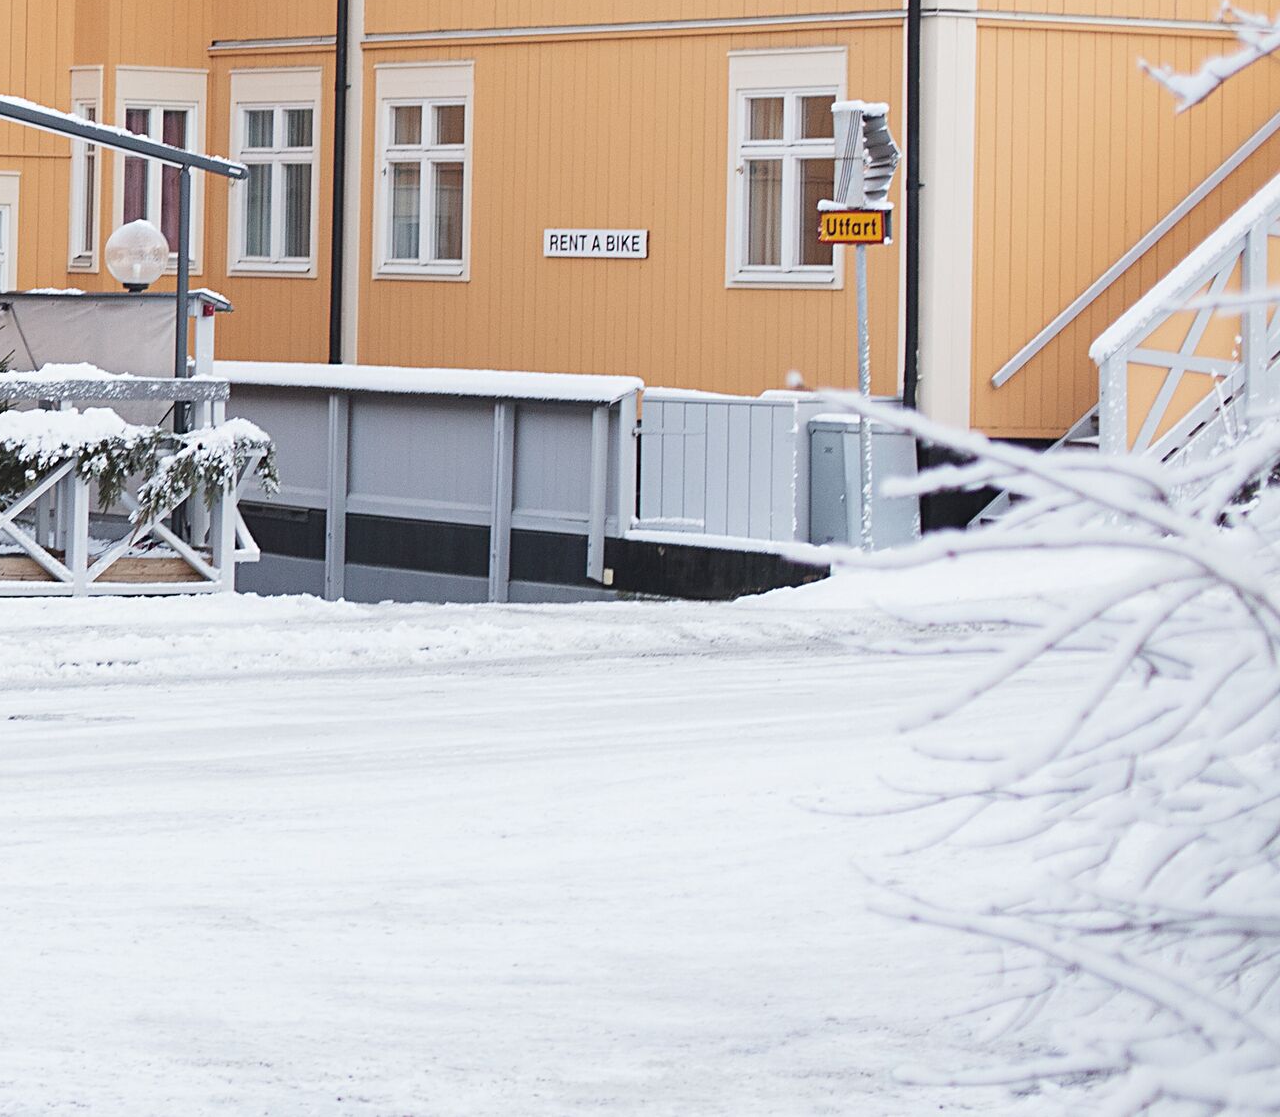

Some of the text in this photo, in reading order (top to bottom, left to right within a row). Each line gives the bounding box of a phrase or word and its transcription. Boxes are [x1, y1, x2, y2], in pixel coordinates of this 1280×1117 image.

[826, 218, 877, 236] Utfart
[549, 234, 641, 253] RENT A BIKE
